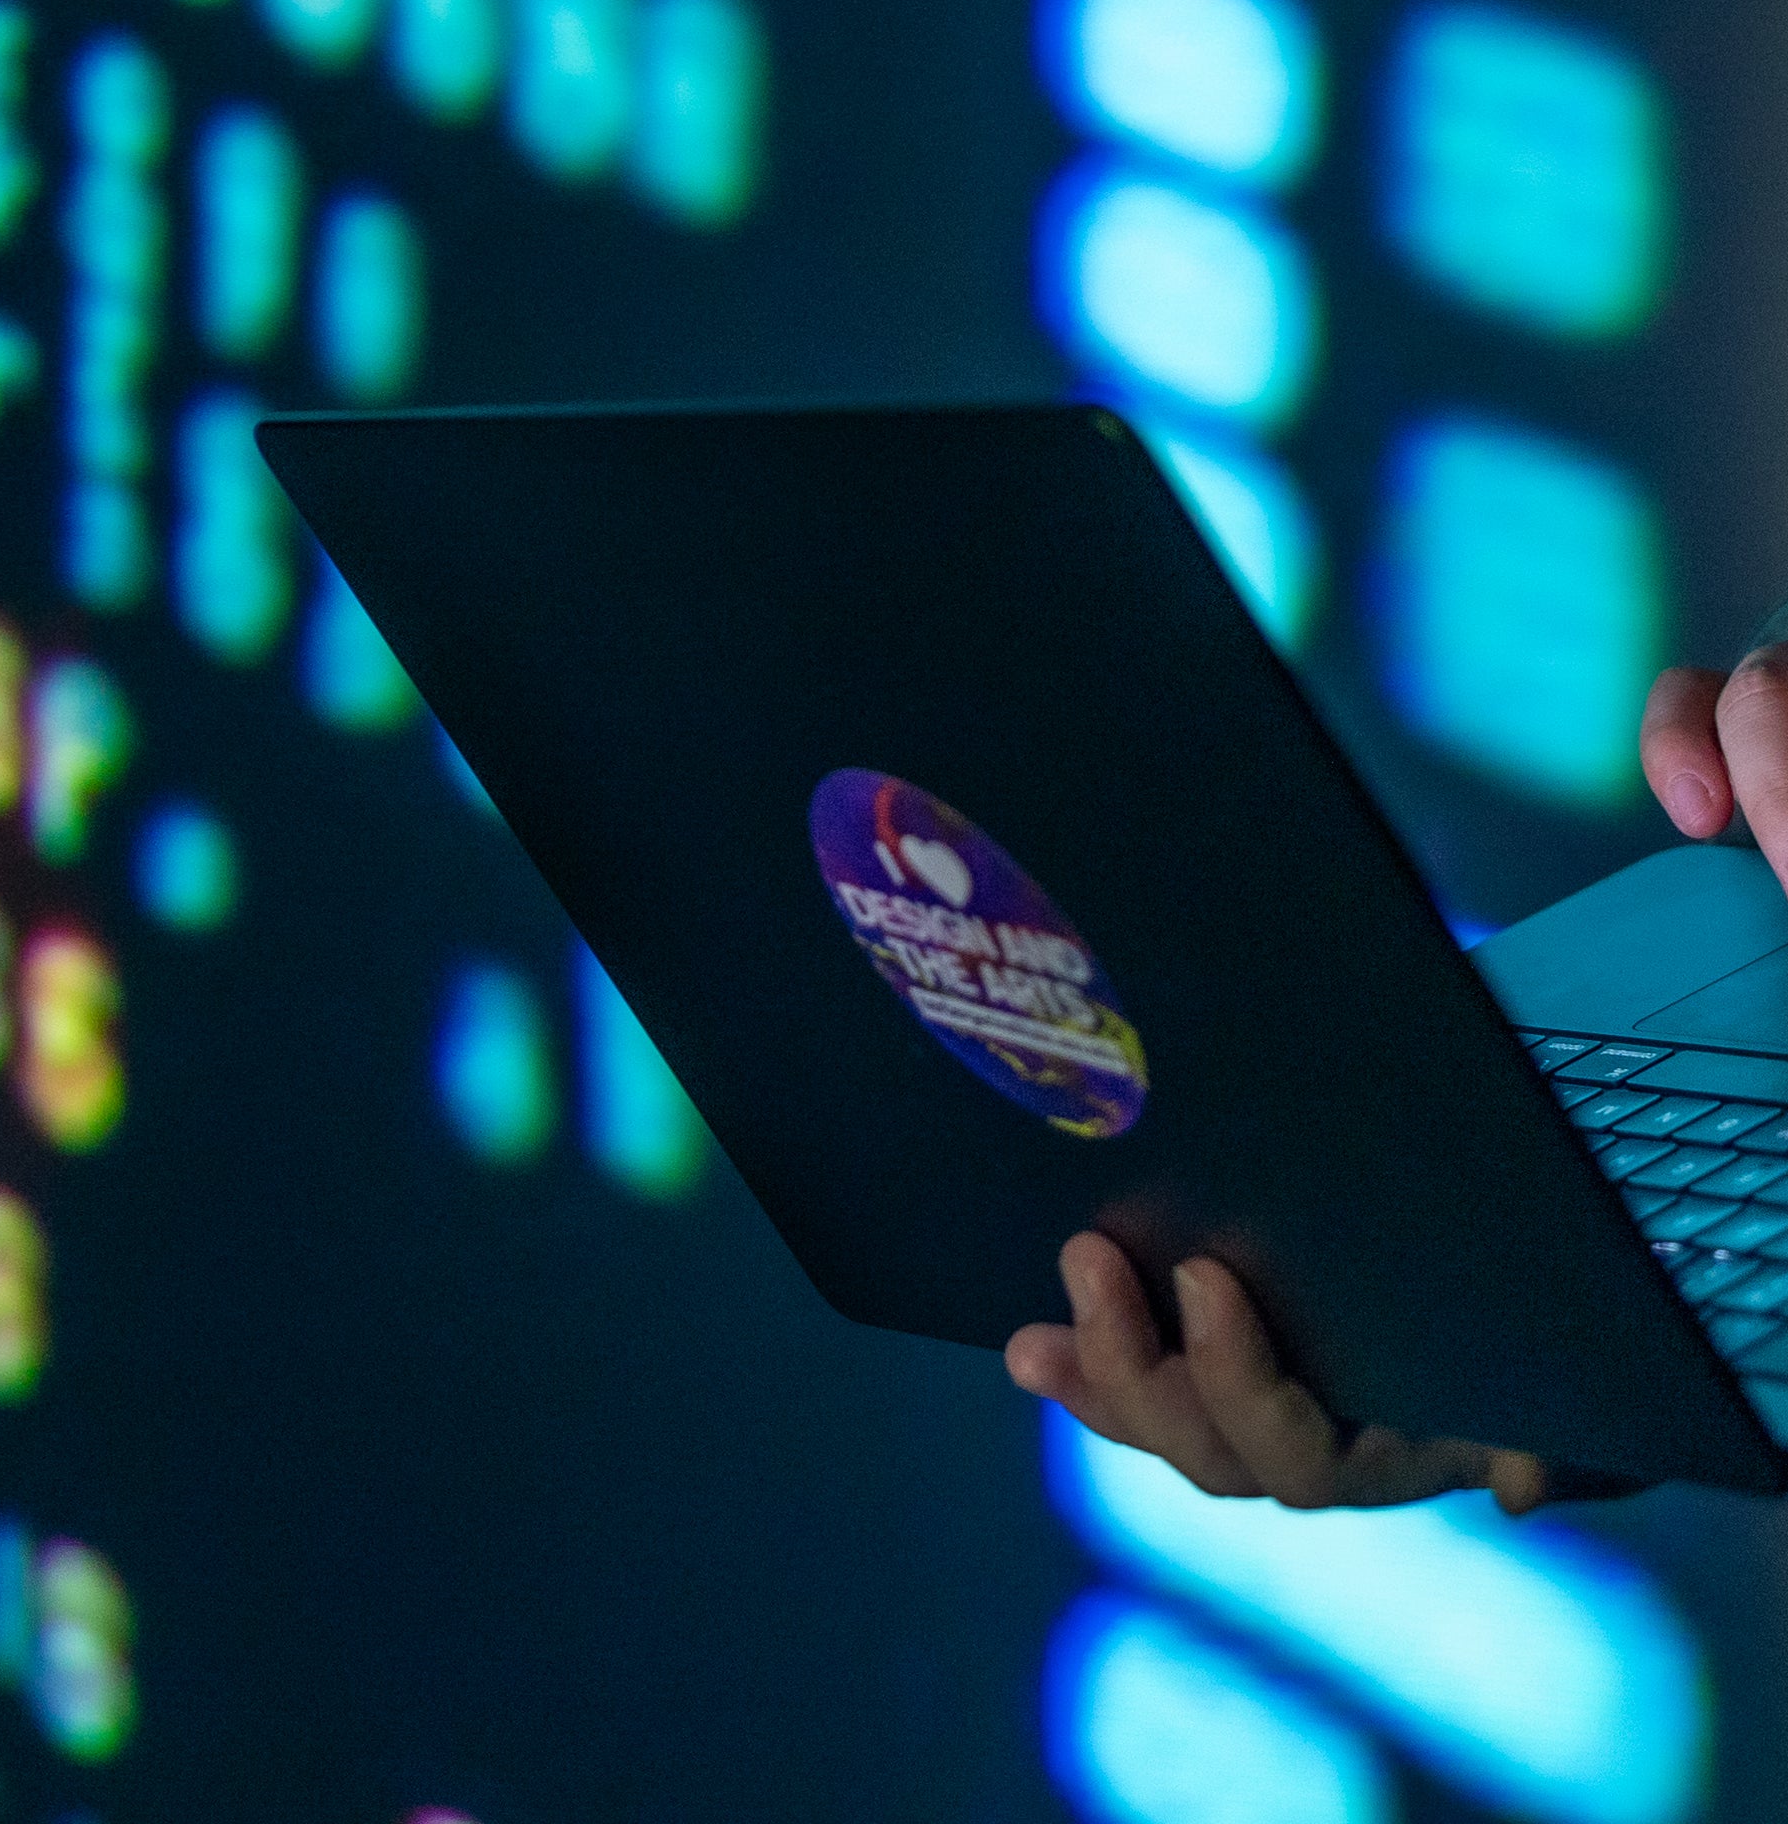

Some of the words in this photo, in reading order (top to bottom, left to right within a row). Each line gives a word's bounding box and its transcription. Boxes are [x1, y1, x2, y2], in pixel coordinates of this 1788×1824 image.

[836, 881, 1001, 960] DESIGN
[993, 921, 1091, 986] AND
[881, 935, 983, 998] THE
[978, 960, 1099, 1031] ARTS
